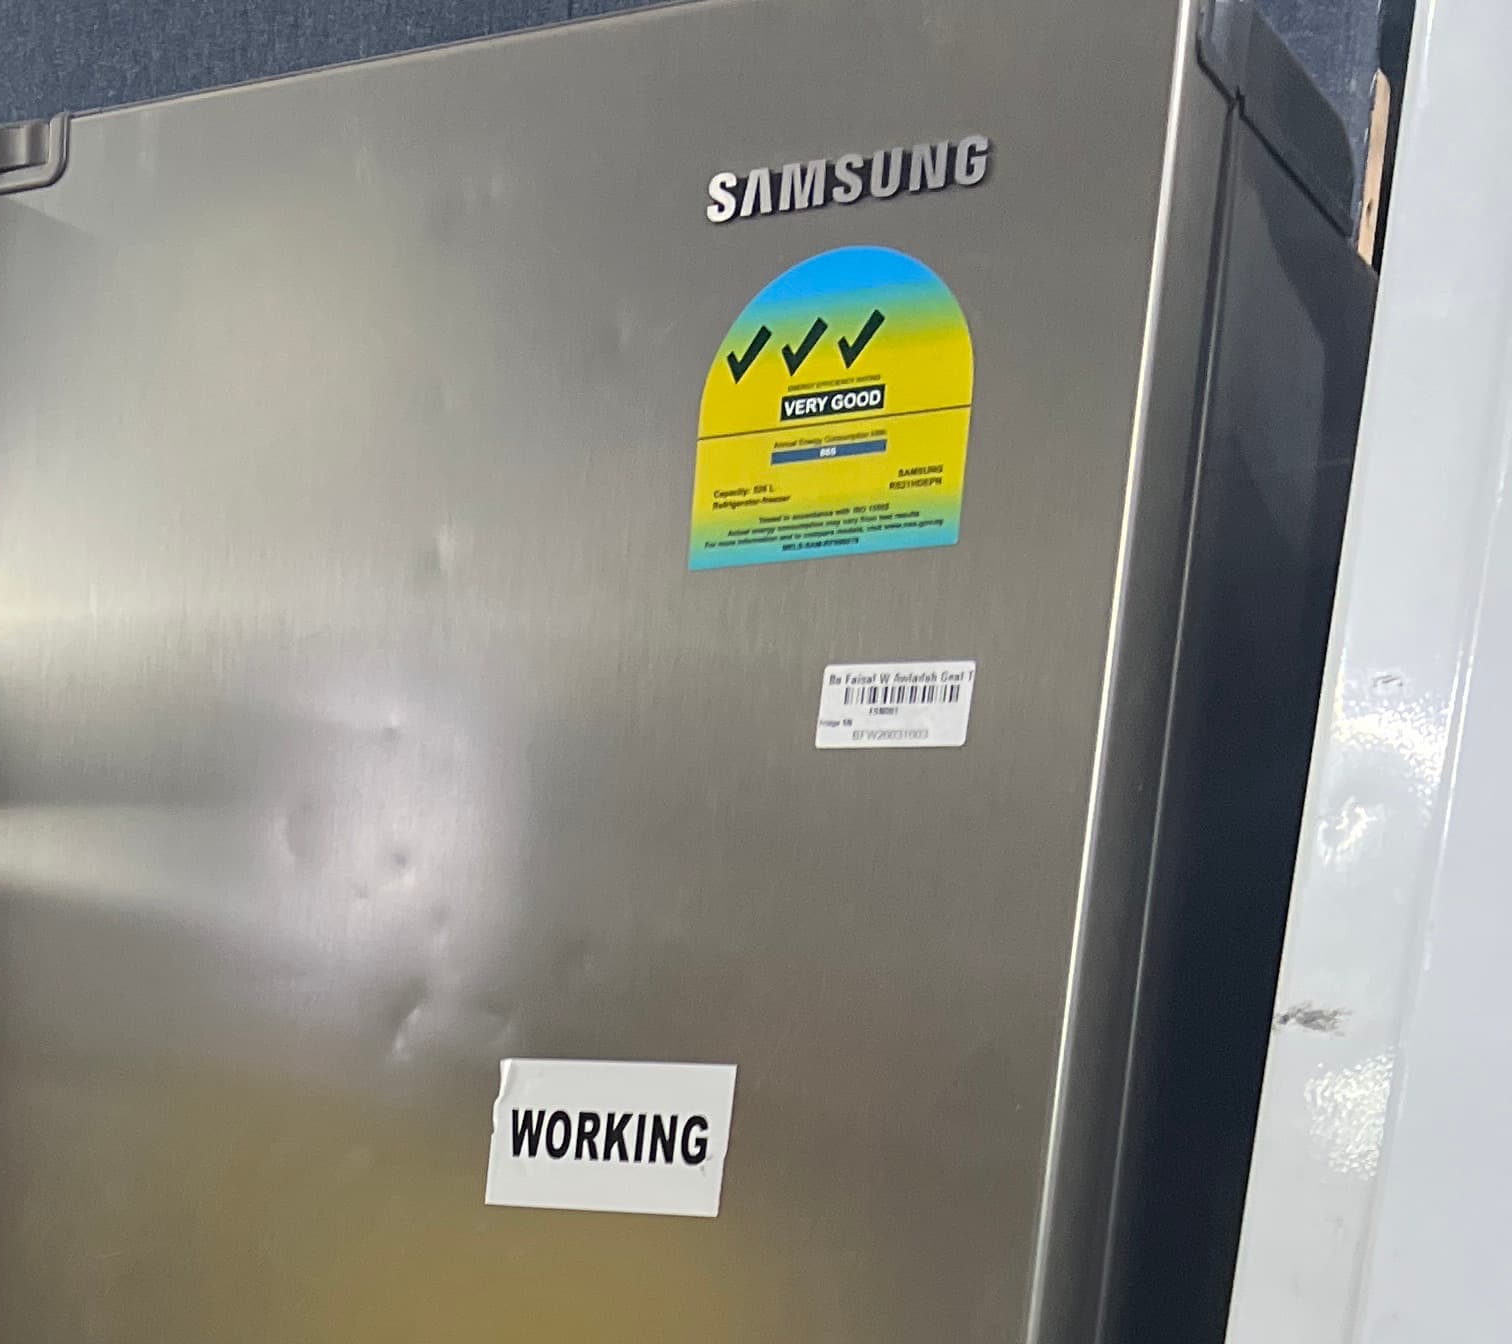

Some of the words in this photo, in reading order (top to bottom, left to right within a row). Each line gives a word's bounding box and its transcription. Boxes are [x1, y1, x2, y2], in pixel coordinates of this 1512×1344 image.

[705, 134, 989, 224] SAMSUNG
[783, 395, 829, 417] VERY
[830, 389, 882, 411] GOOD
[845, 672, 877, 685] Faisal
[511, 1108, 709, 1166] WORKING
